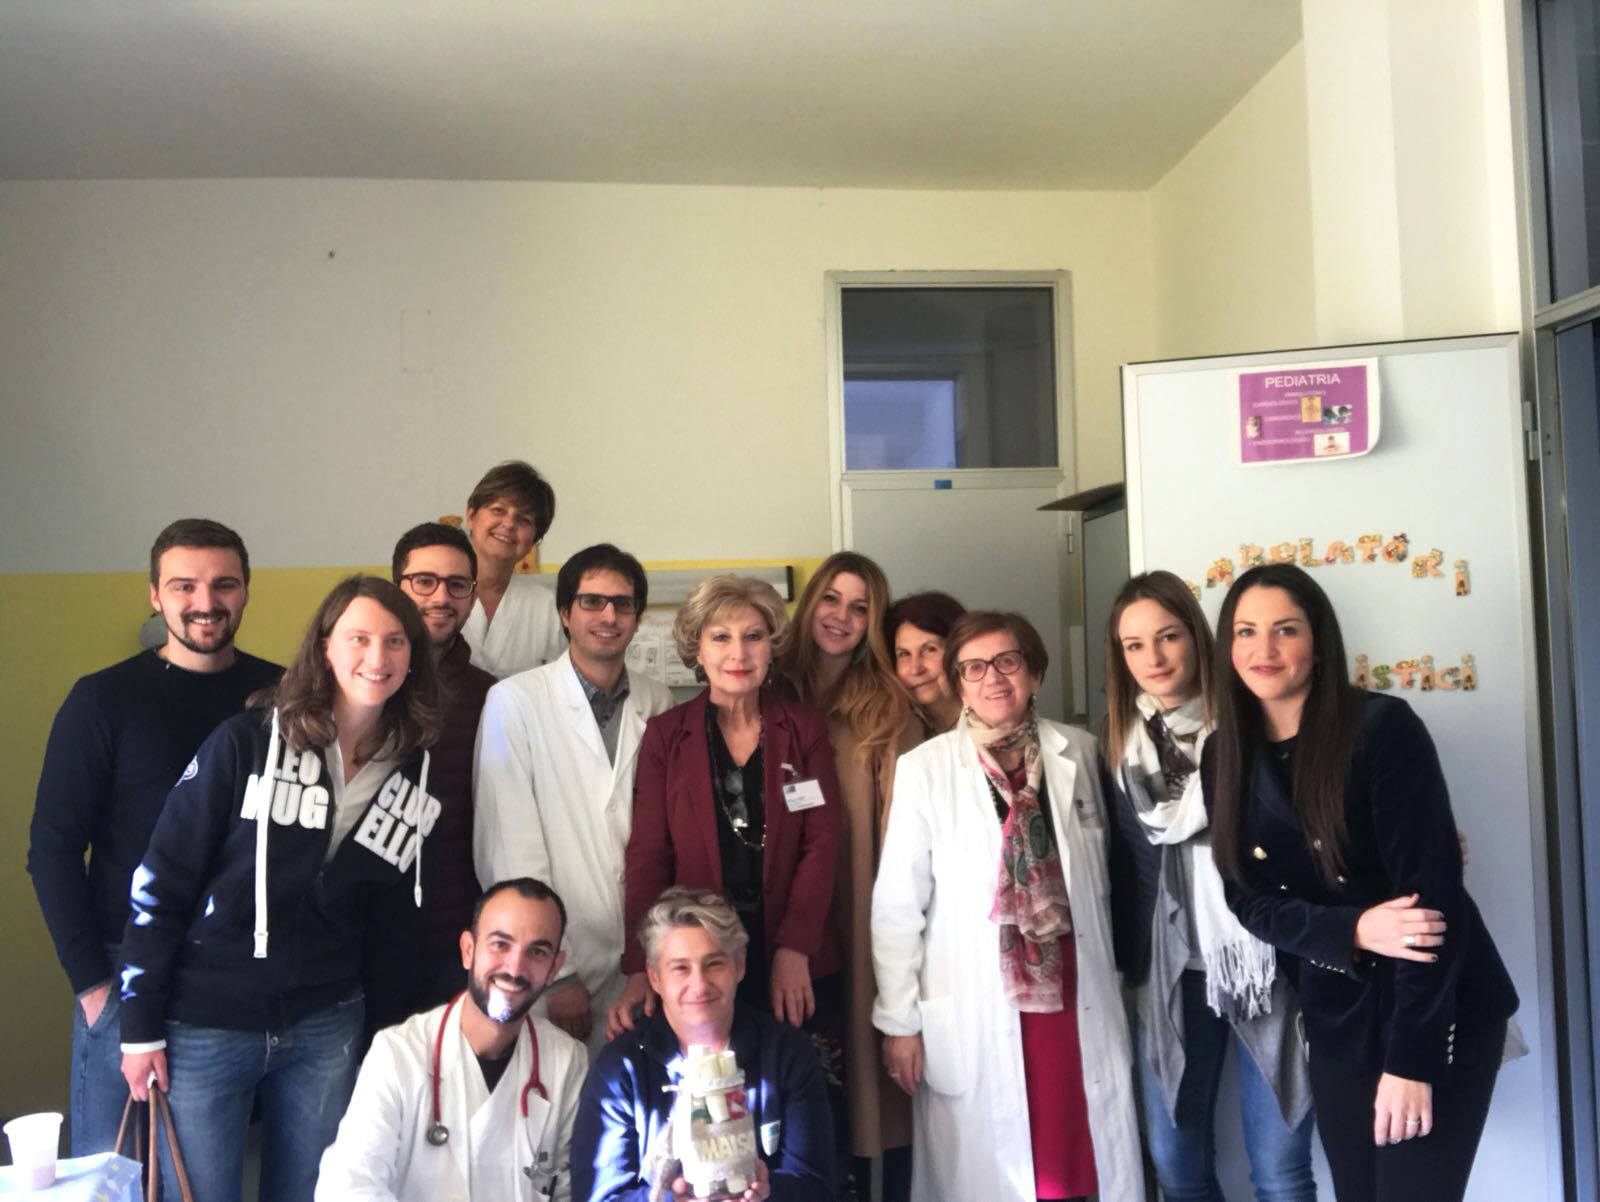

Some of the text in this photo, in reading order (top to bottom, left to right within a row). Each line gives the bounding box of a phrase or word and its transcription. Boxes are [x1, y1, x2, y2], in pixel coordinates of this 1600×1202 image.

[1265, 373, 1341, 389] PEDIATRIA
[240, 774, 424, 874] MUG ELLO
[378, 771, 442, 837] CLUB
